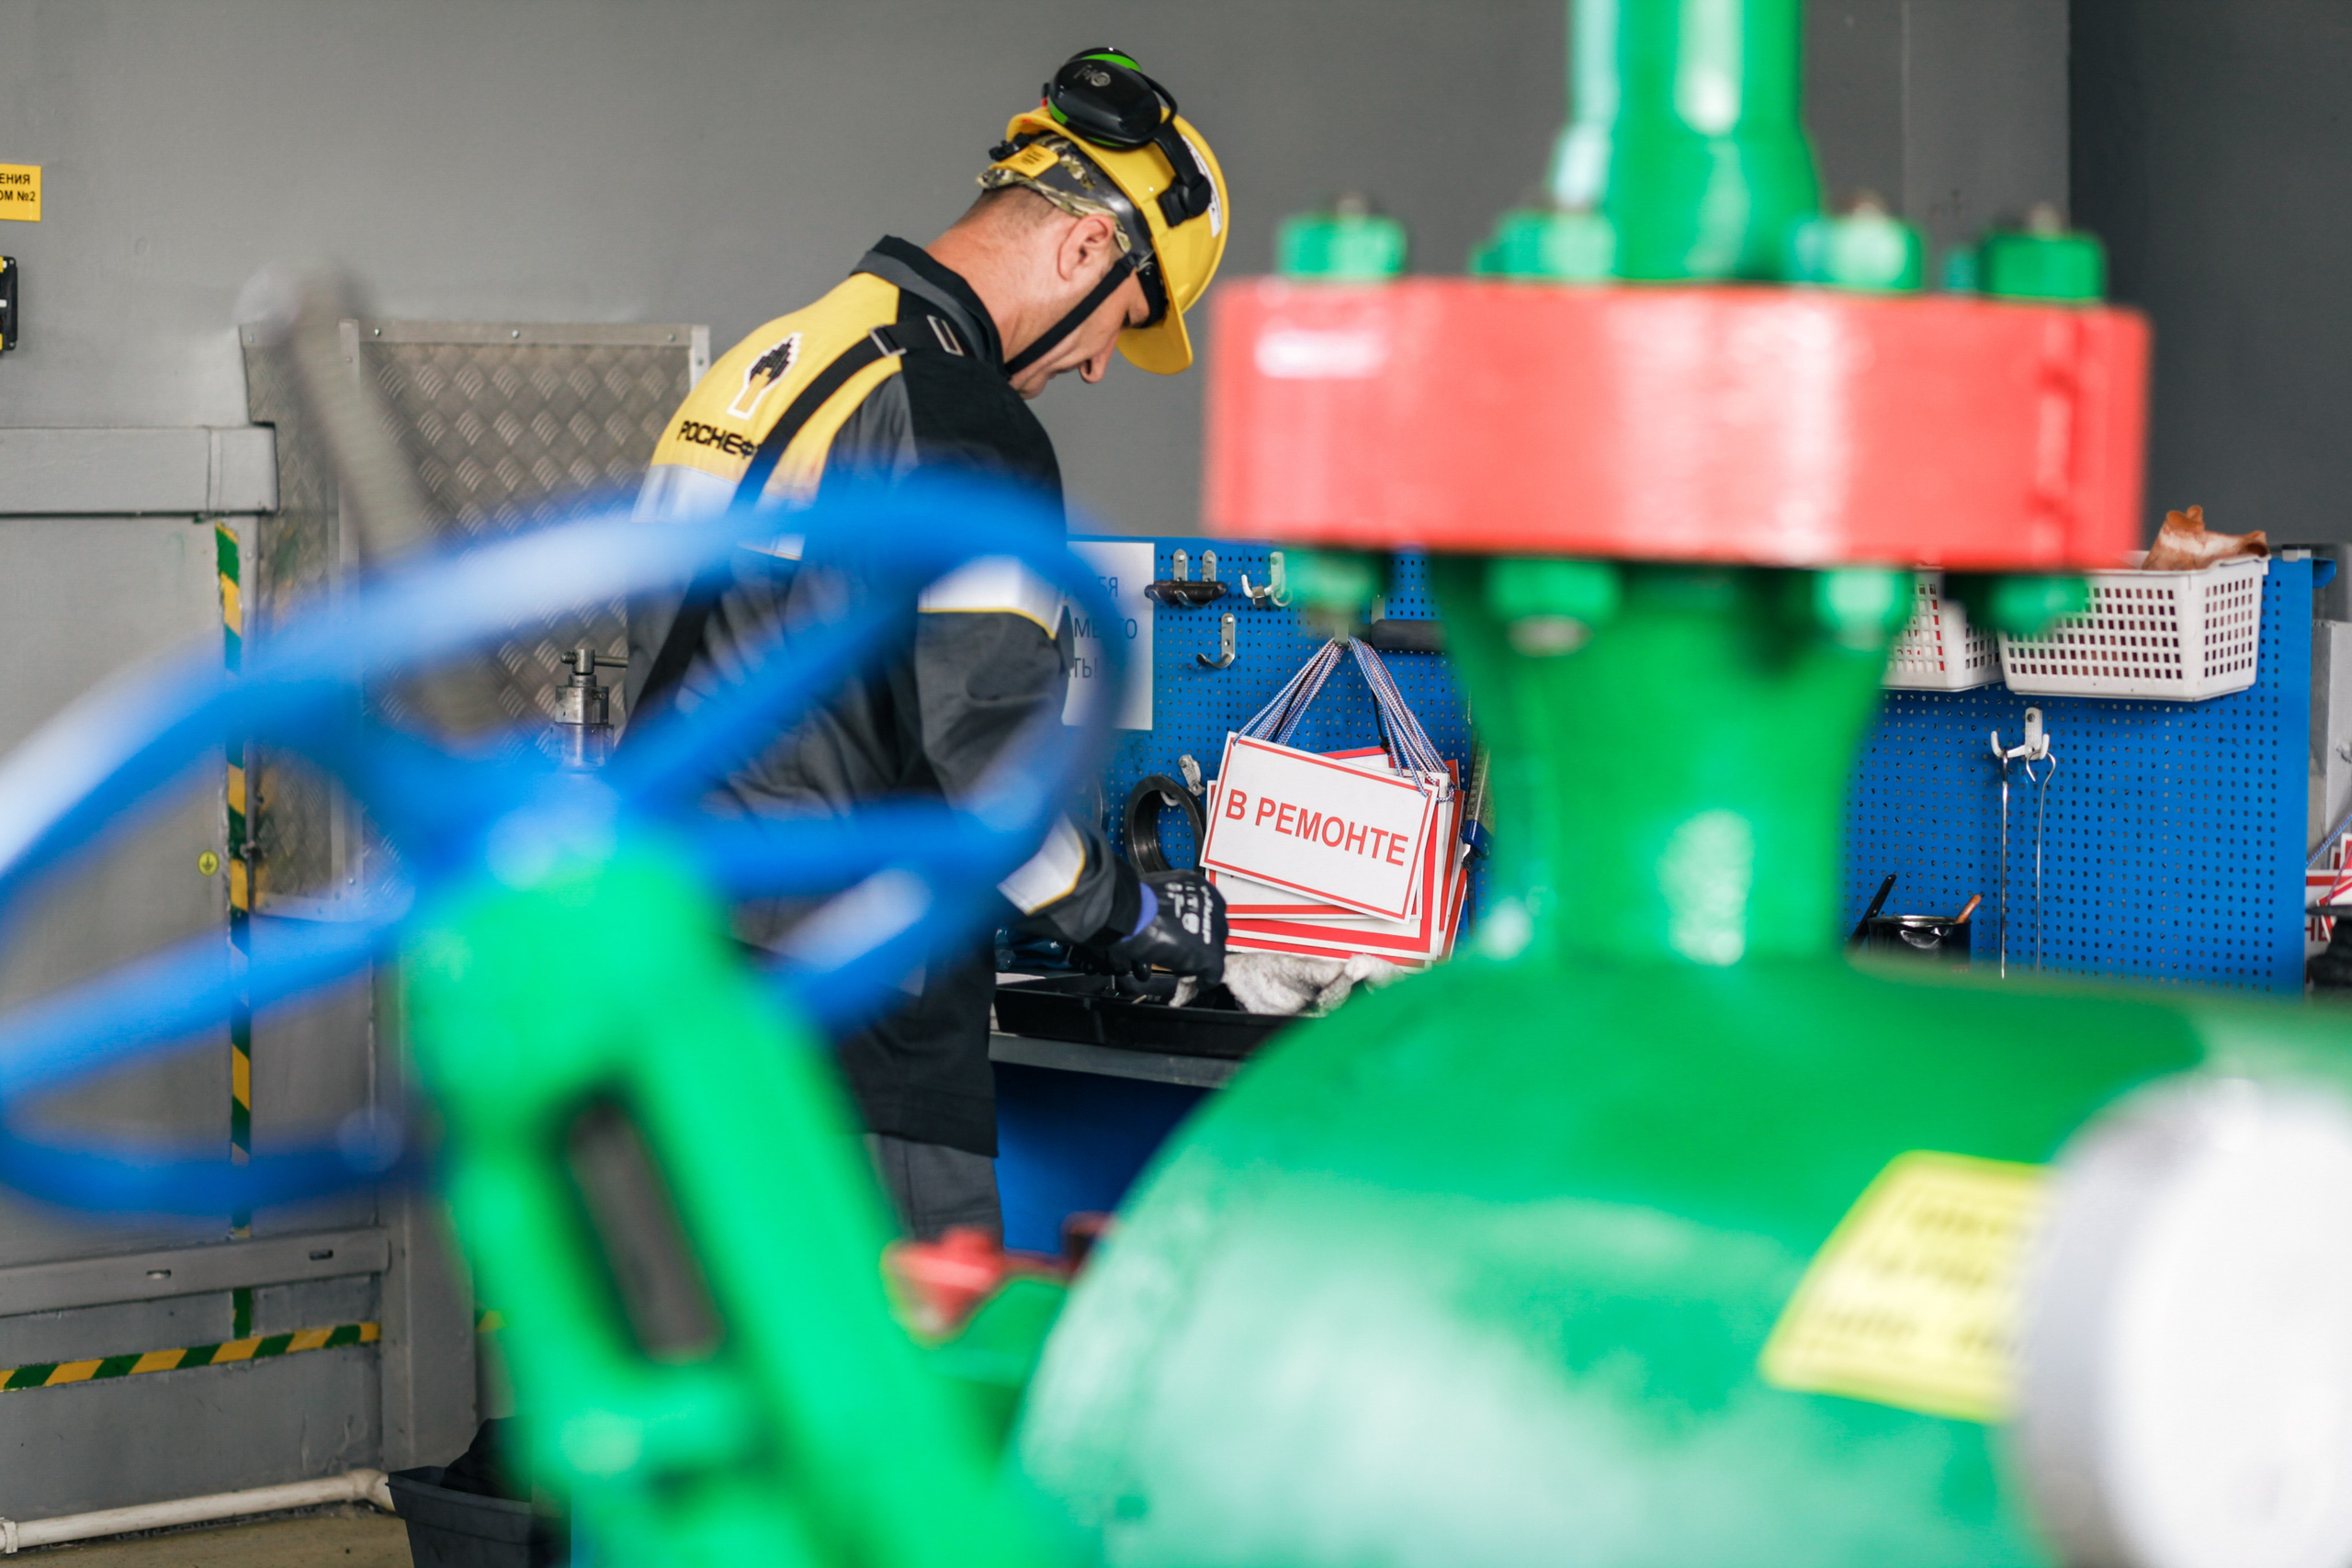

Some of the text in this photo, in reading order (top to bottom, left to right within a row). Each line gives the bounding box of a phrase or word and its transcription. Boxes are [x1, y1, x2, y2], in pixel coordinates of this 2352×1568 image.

[676, 420, 757, 459] РОСНЕФ
[1225, 789, 1409, 867] В РЕМОНТЕ
